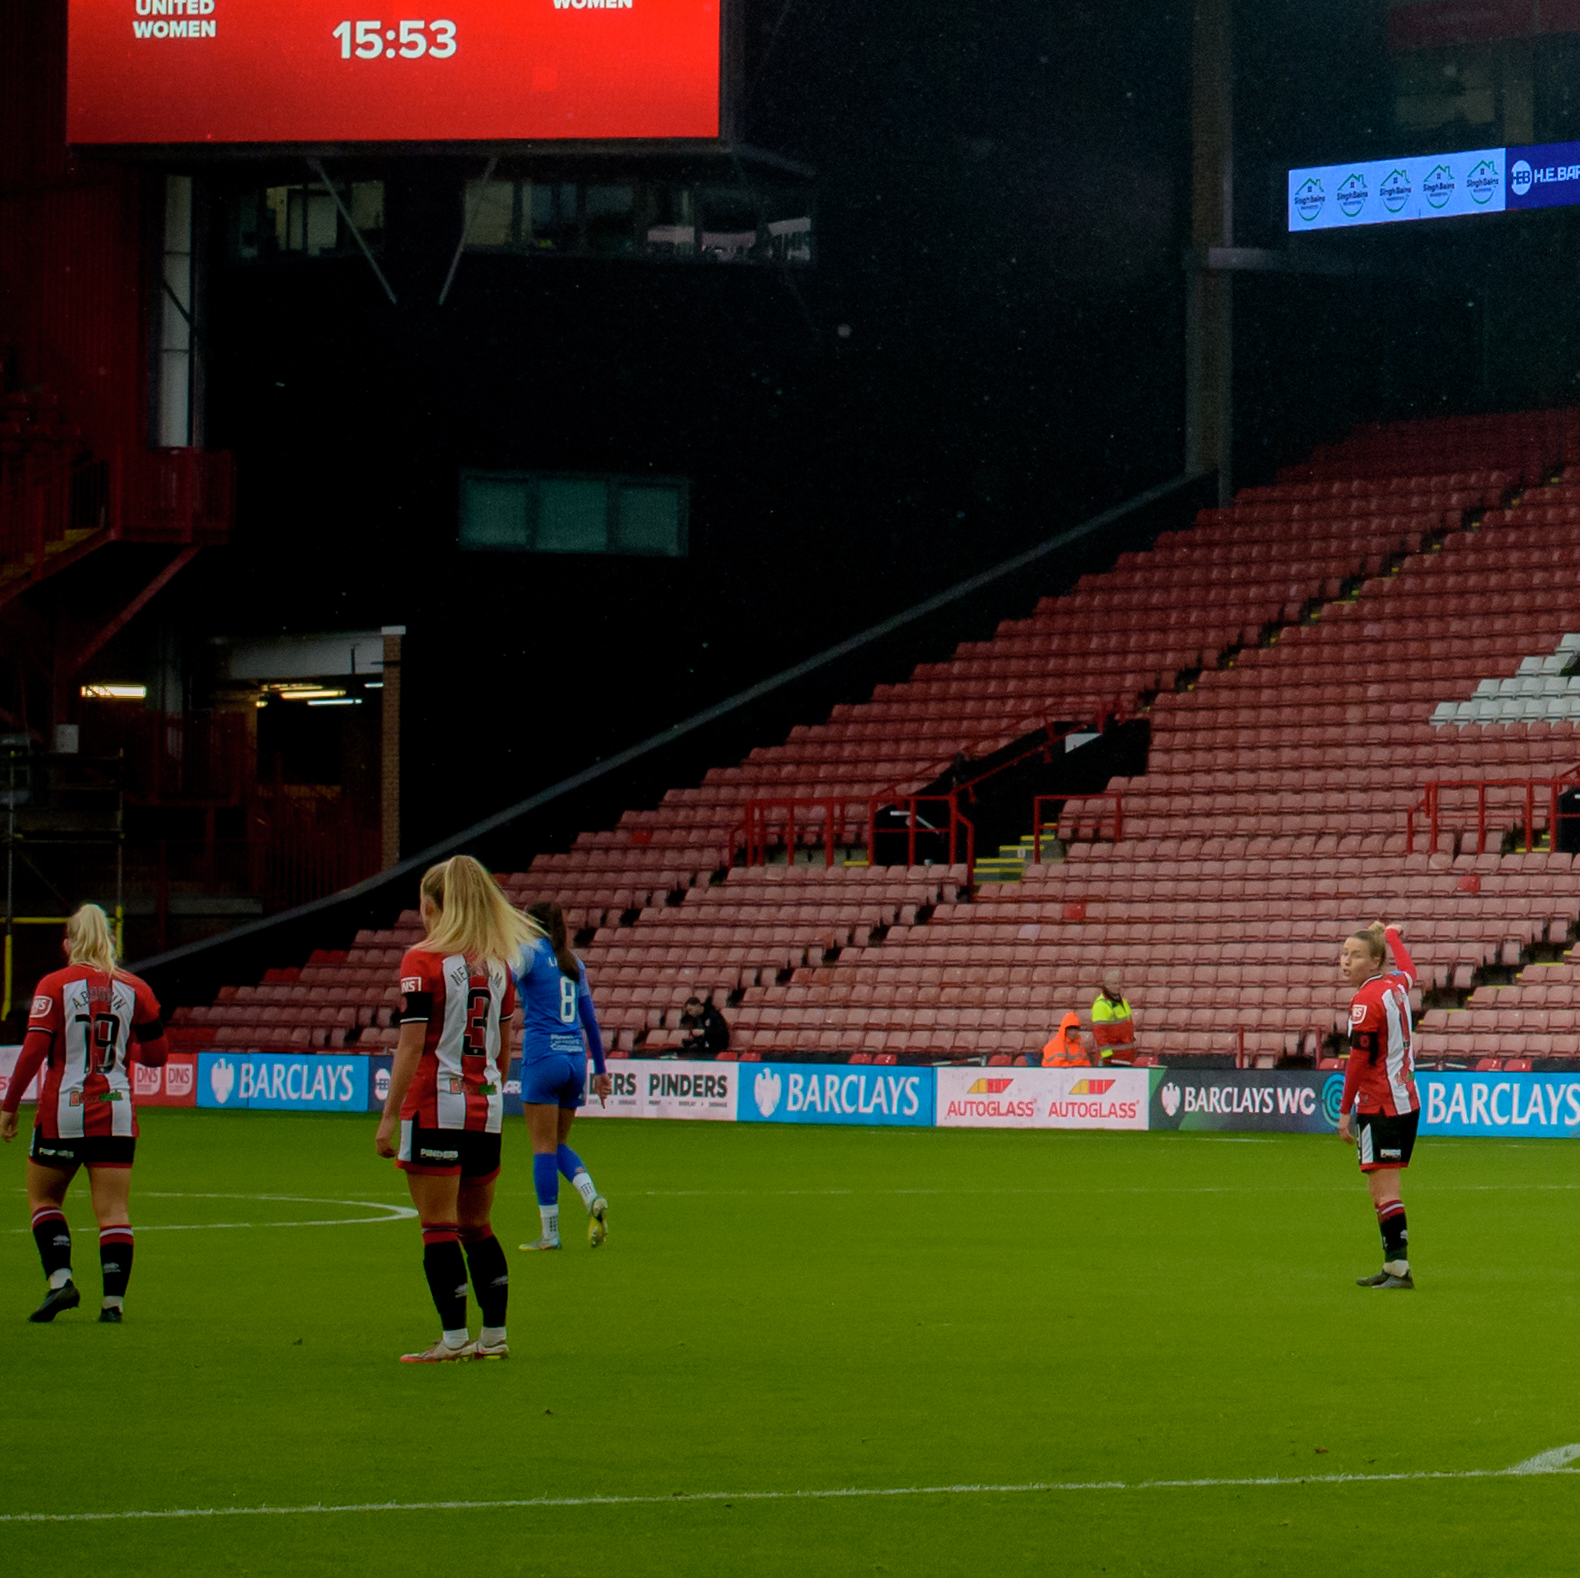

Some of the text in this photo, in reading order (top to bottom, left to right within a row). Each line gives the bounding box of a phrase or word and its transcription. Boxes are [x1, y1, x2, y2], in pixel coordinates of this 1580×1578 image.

[132, 20, 217, 38] WOMEN
[332, 20, 458, 60] 15:53
[560, 976, 576, 1023] 8
[463, 987, 491, 1056] 3
[75, 1012, 120, 1073] 19
[137, 1066, 159, 1083] DNS
[168, 1066, 190, 1083] DNS
[239, 1062, 354, 1101] BARCLAYS
[649, 1073, 728, 1099] PINDERS
[787, 1074, 919, 1117] BARCLAYS
[1184, 1086, 1316, 1113] BARCLAYS WC
